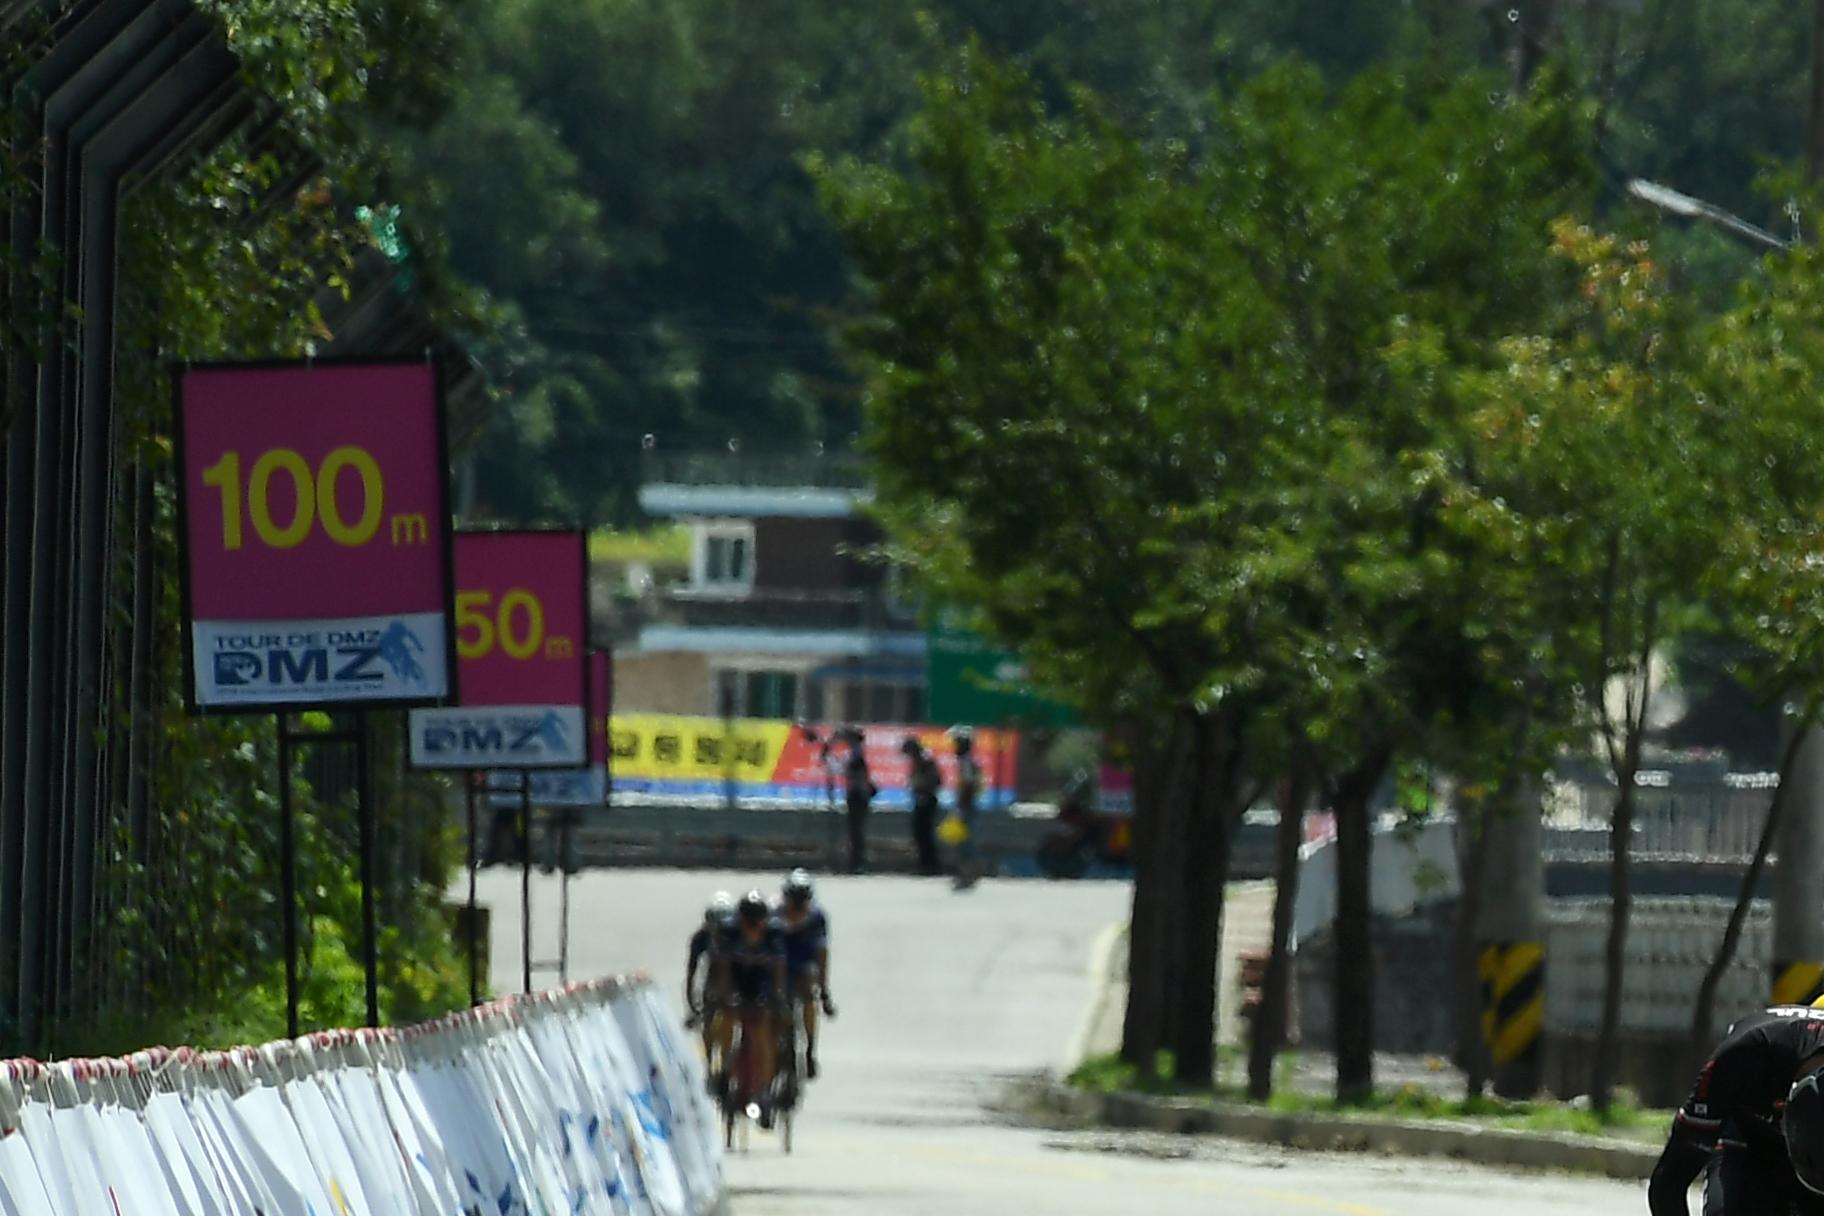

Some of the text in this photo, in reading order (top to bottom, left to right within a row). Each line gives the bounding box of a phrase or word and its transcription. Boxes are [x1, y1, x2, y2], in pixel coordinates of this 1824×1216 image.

[215, 635, 281, 649] TOUR
[327, 630, 380, 645] DMZ
[214, 647, 384, 685] DMZ
[424, 722, 543, 752] DMZ
